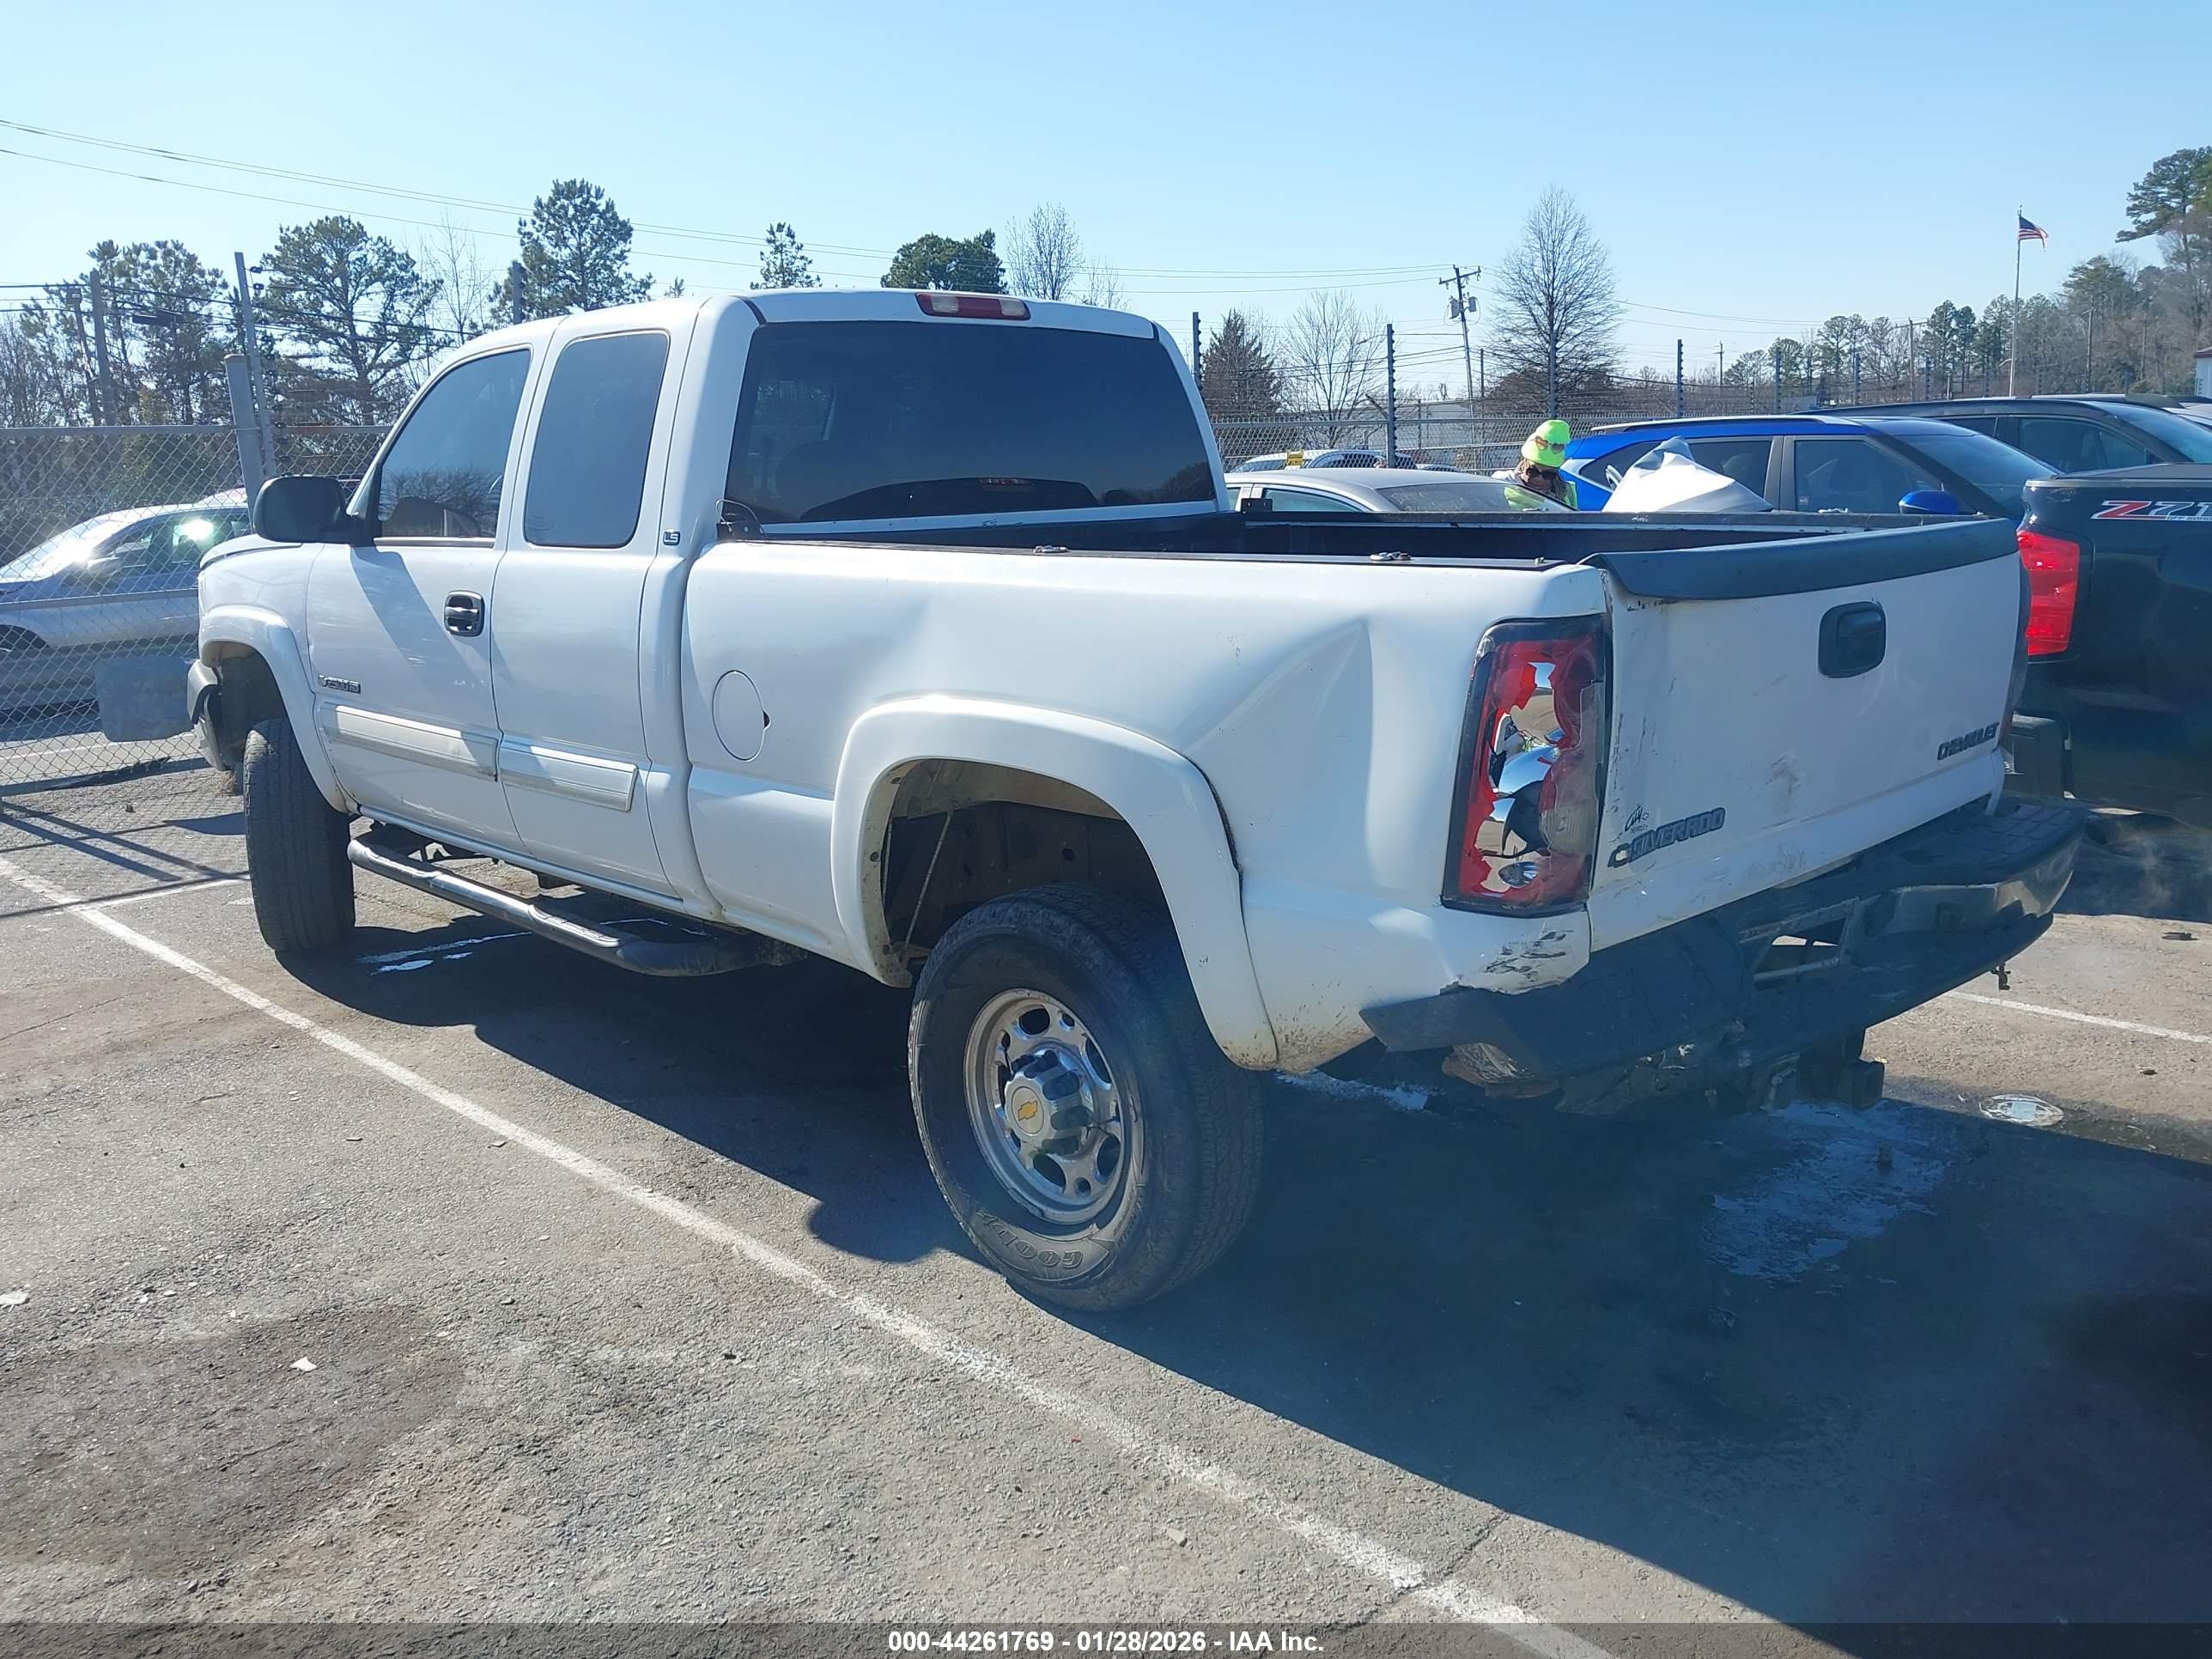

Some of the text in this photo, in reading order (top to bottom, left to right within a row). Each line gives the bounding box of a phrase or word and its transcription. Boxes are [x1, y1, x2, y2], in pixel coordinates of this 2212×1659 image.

[664, 532, 678, 543] LS
[1937, 721, 2000, 761] CHEVROLET
[1627, 807, 1726, 863] SILVERADO
